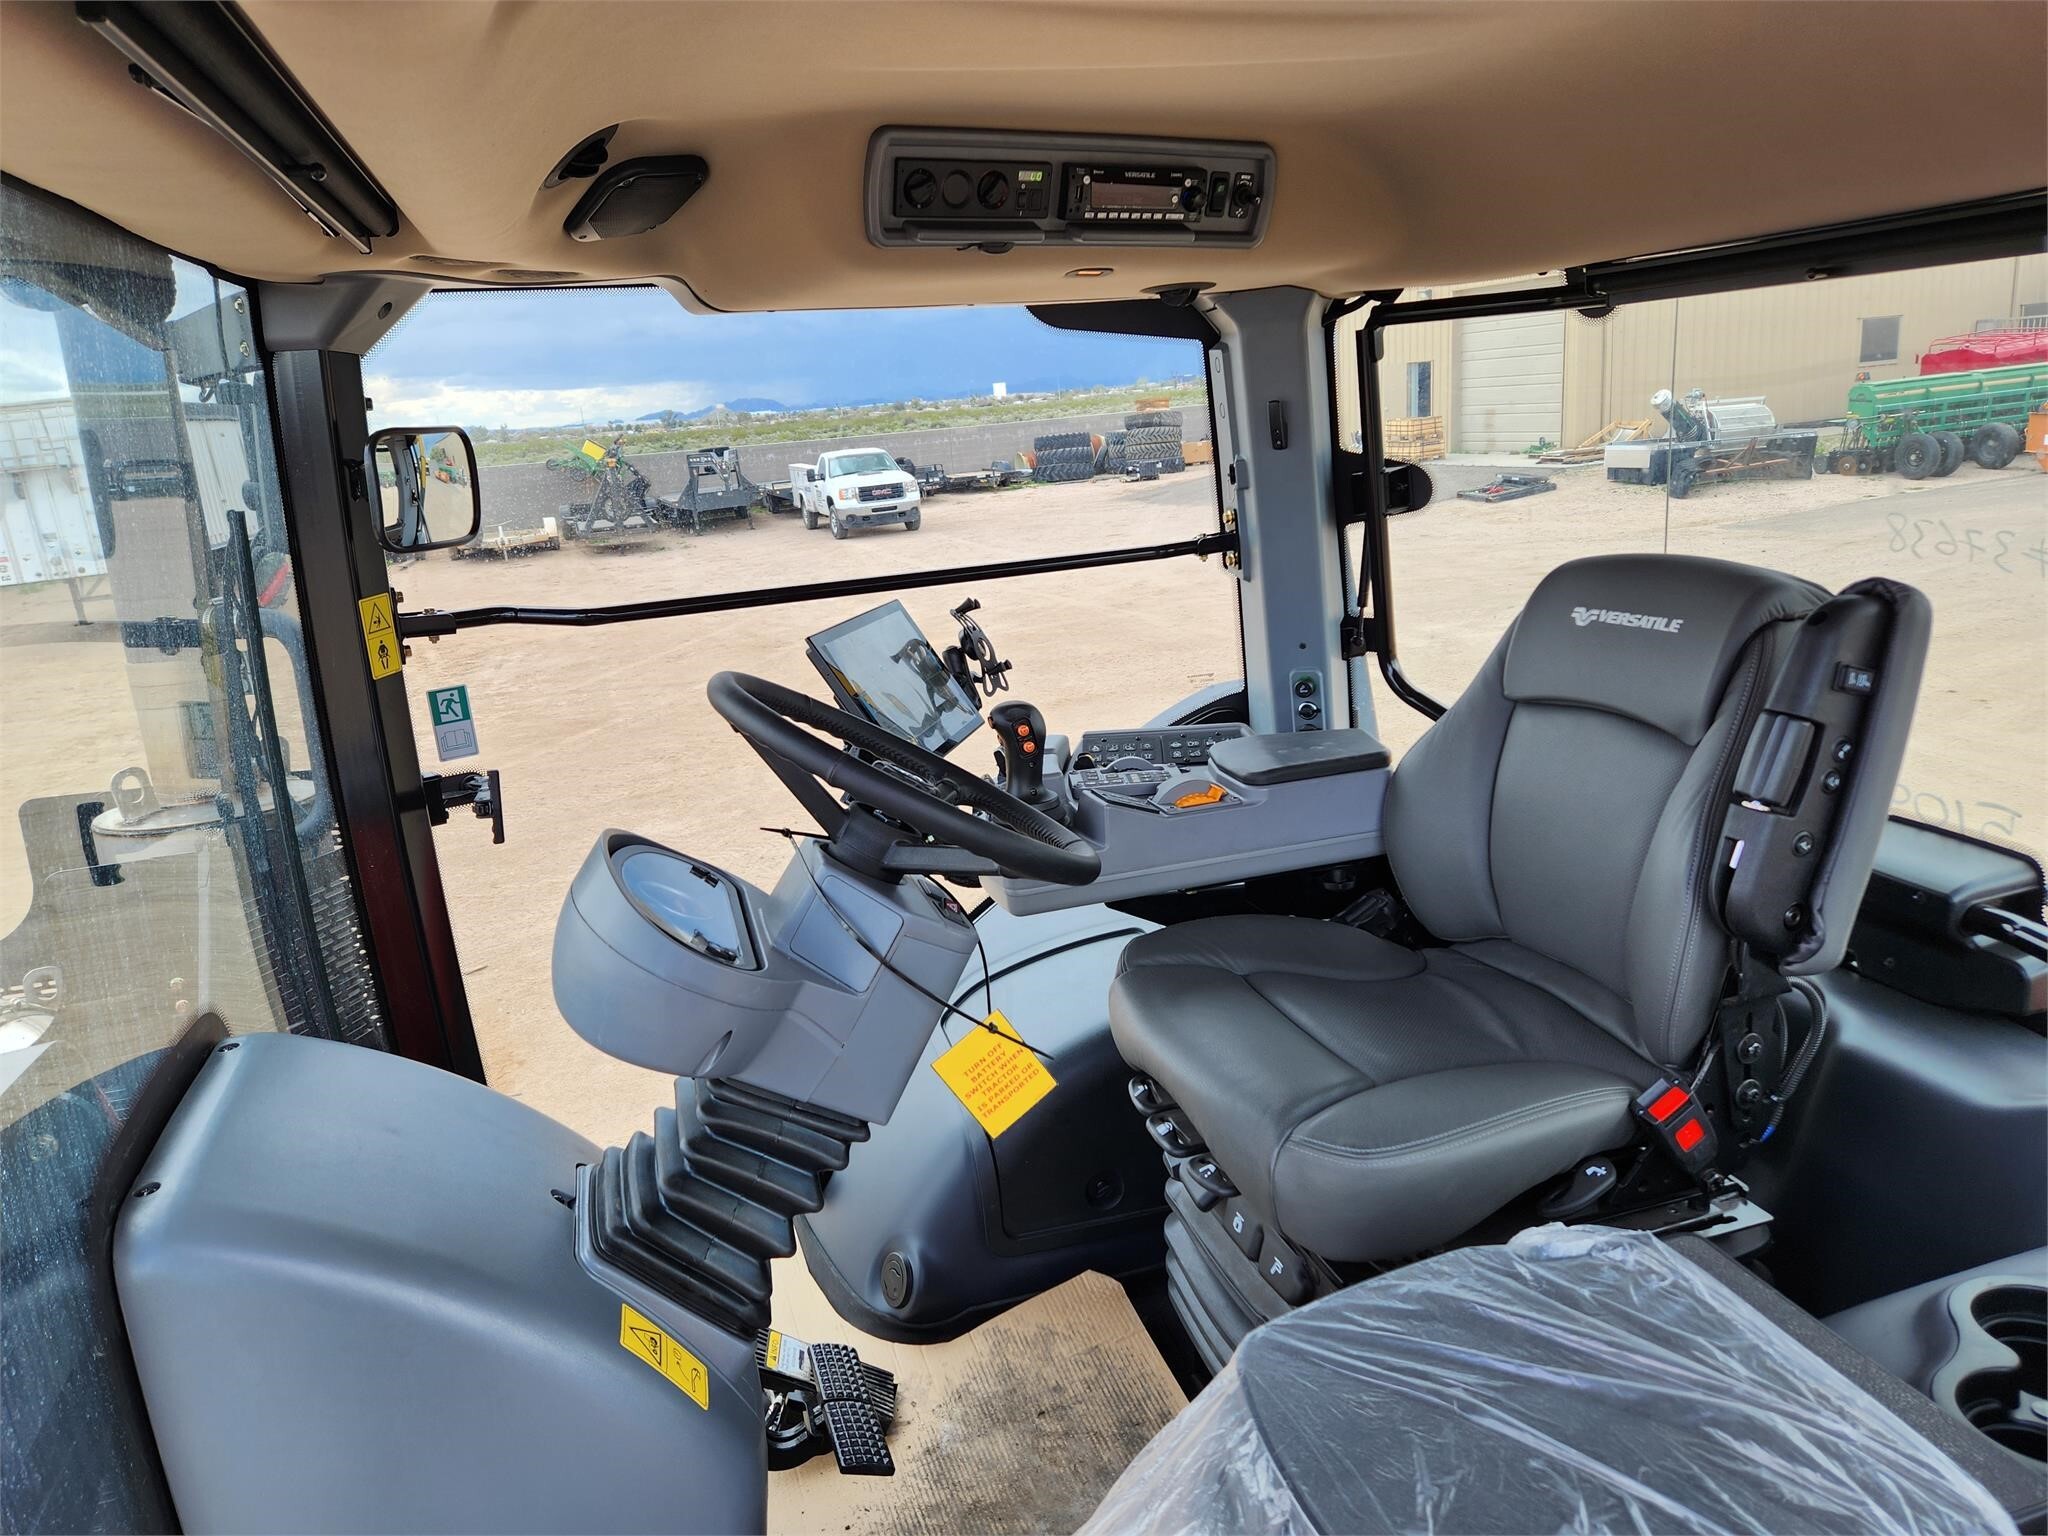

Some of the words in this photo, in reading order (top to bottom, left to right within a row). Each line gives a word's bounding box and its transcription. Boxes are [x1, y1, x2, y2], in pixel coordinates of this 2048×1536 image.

[871, 488, 892, 496] GMC
[1598, 609, 1684, 633] VERSATILE
[963, 1056, 986, 1077] TURN
[987, 1043, 1003, 1057] OFF
[964, 1070, 998, 1100] SWITCH
[999, 1048, 1024, 1071] WHEN
[970, 1050, 1006, 1083] BATTERY
[977, 1101, 988, 1112] IS
[988, 1073, 1020, 1103] PARKED
[1021, 1062, 1034, 1075] OR
[982, 1064, 1019, 1097] TRACTOR
[982, 1068, 1040, 1118] TRANSPORTED
